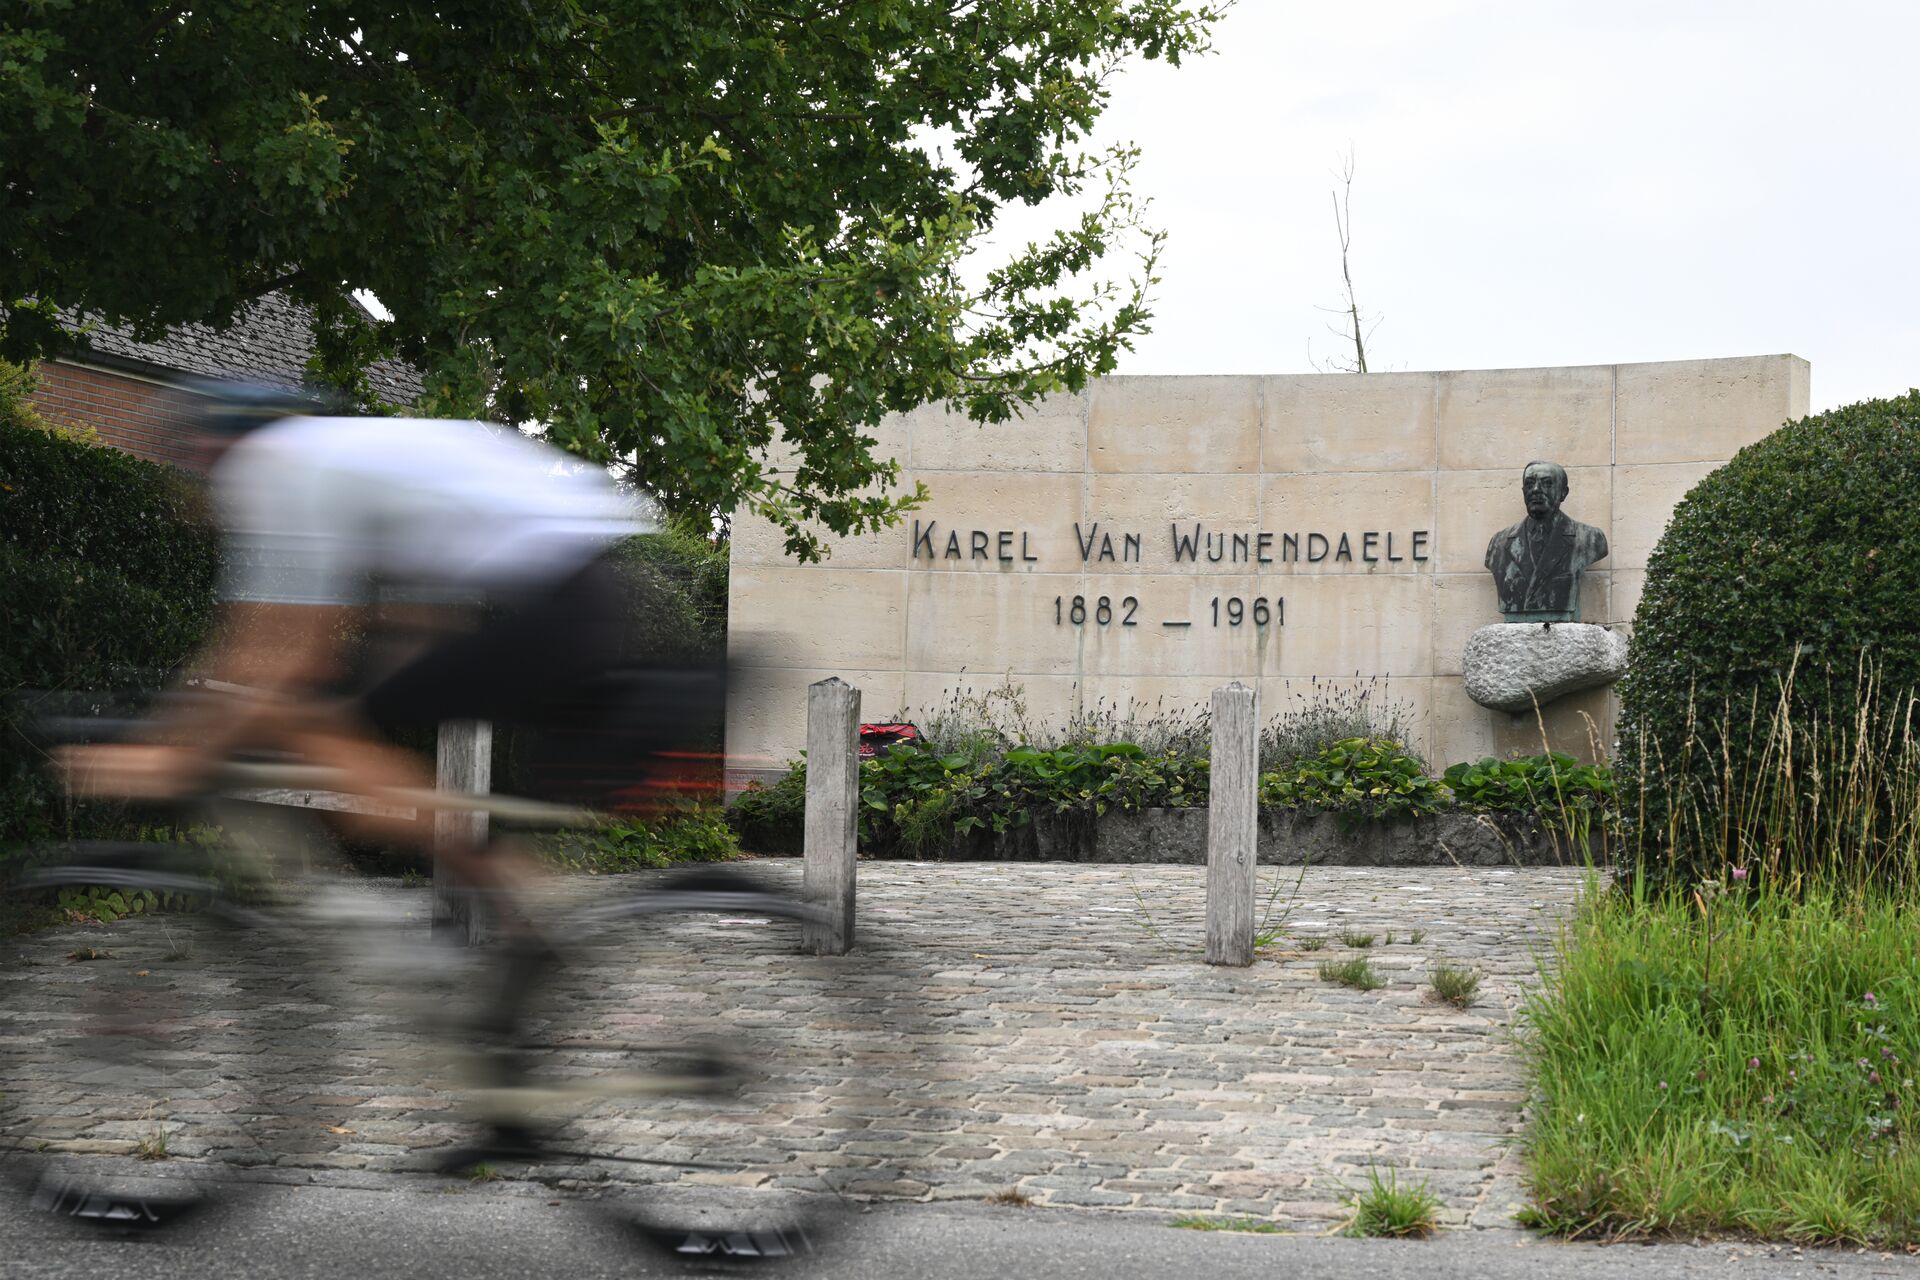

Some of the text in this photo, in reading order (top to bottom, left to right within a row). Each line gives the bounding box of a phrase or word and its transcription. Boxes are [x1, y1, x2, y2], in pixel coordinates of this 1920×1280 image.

[913, 519, 1038, 562] KAREL
[1074, 522, 1141, 563] VAN
[1055, 595, 1139, 626] 1882
[1211, 597, 1285, 627] 1961
